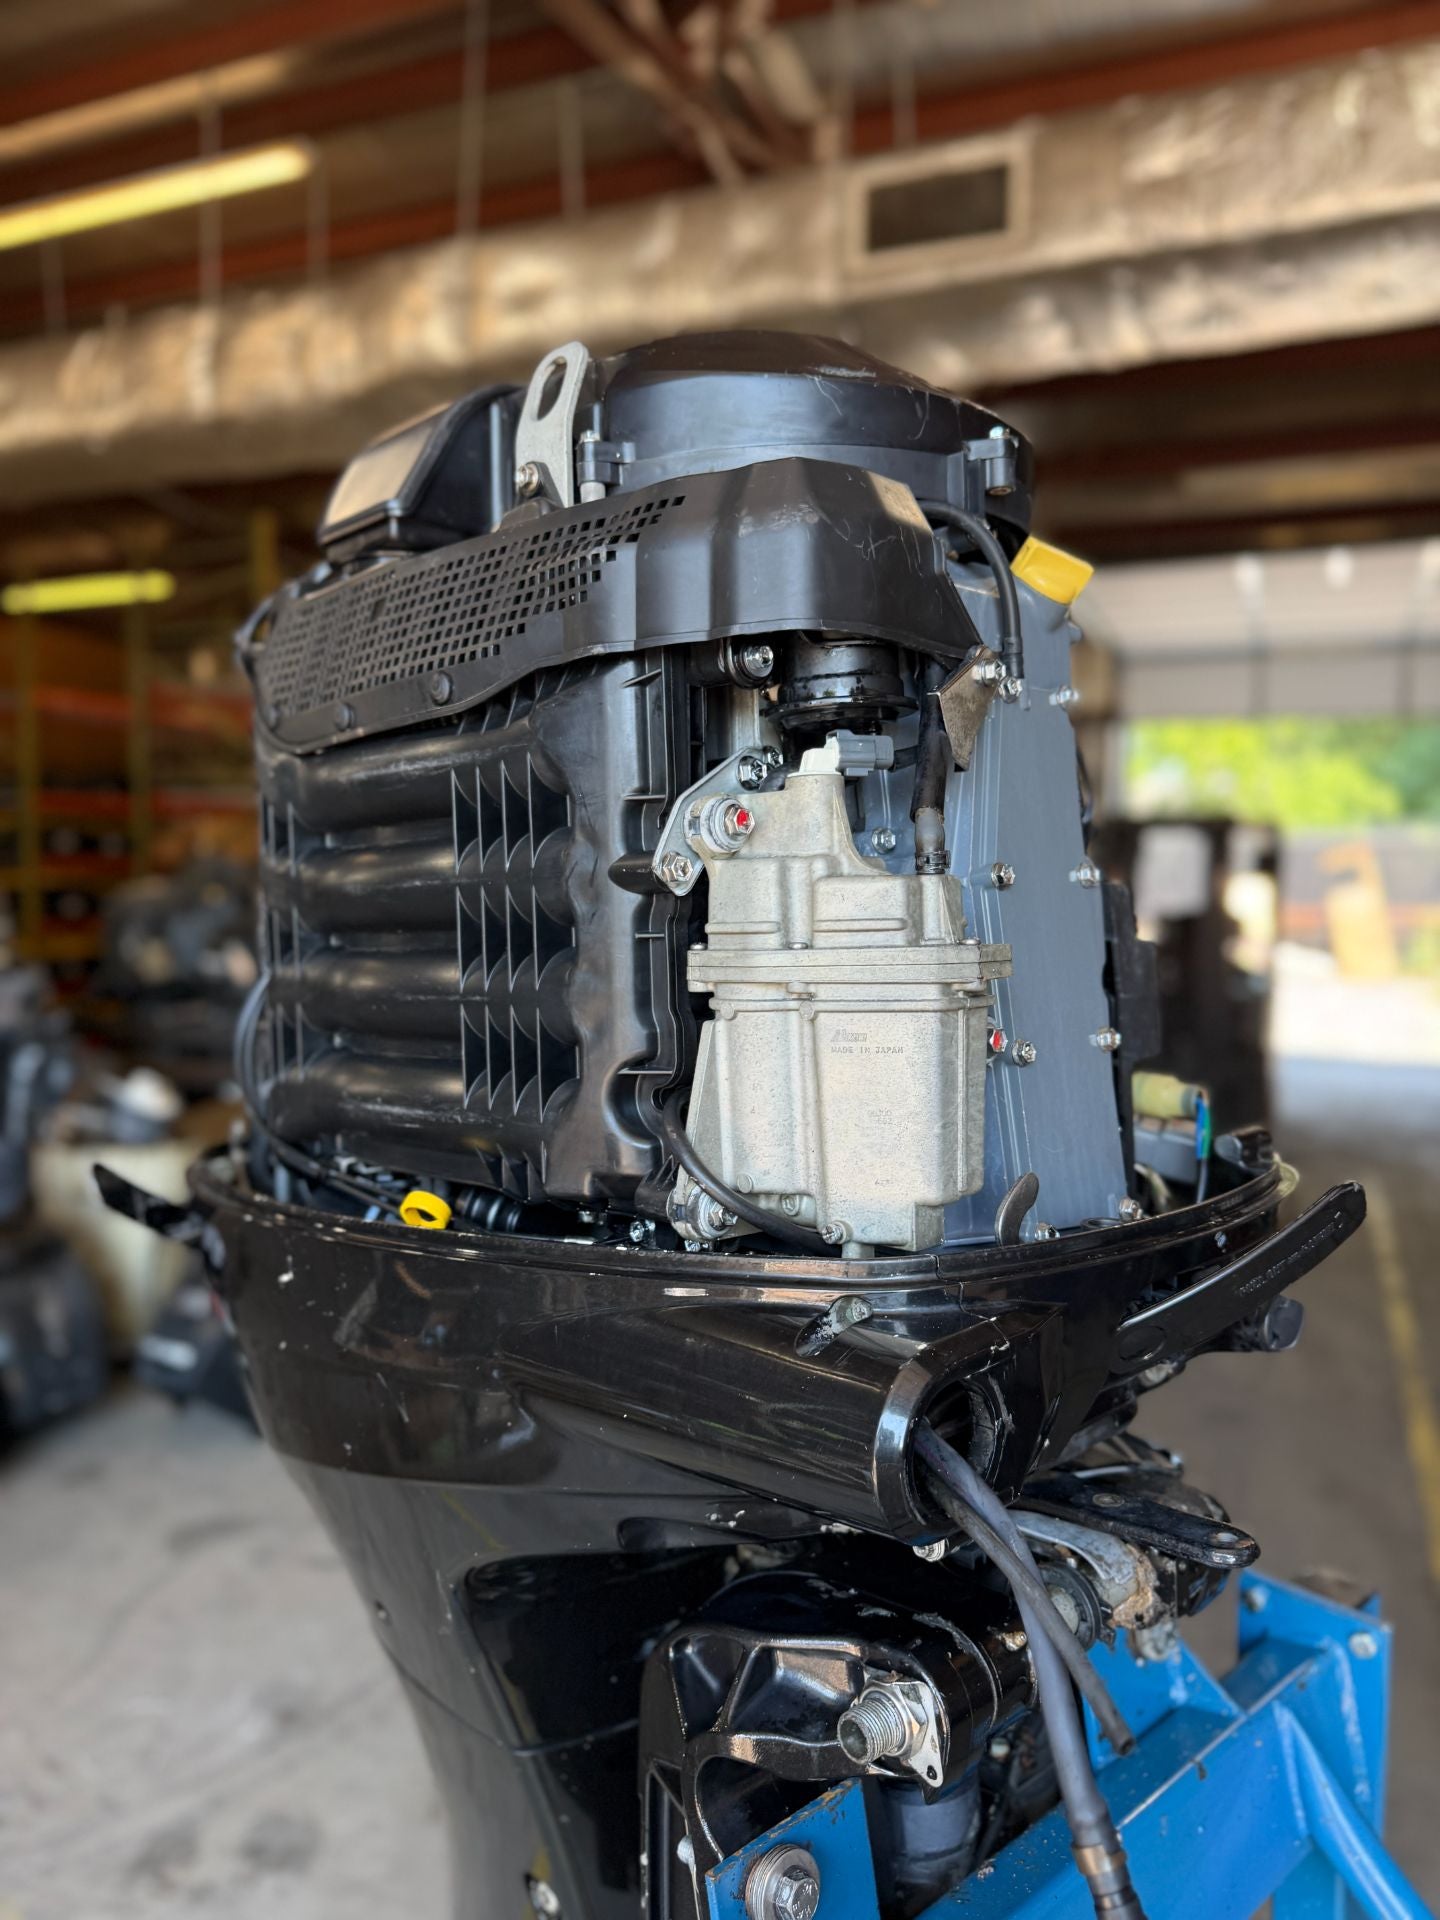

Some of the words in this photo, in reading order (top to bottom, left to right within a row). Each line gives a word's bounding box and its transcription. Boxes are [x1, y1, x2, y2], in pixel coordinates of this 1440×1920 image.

[831, 1046, 854, 1054] MADE
[860, 1046, 870, 1054] IN
[875, 1046, 903, 1054] JAPAN
